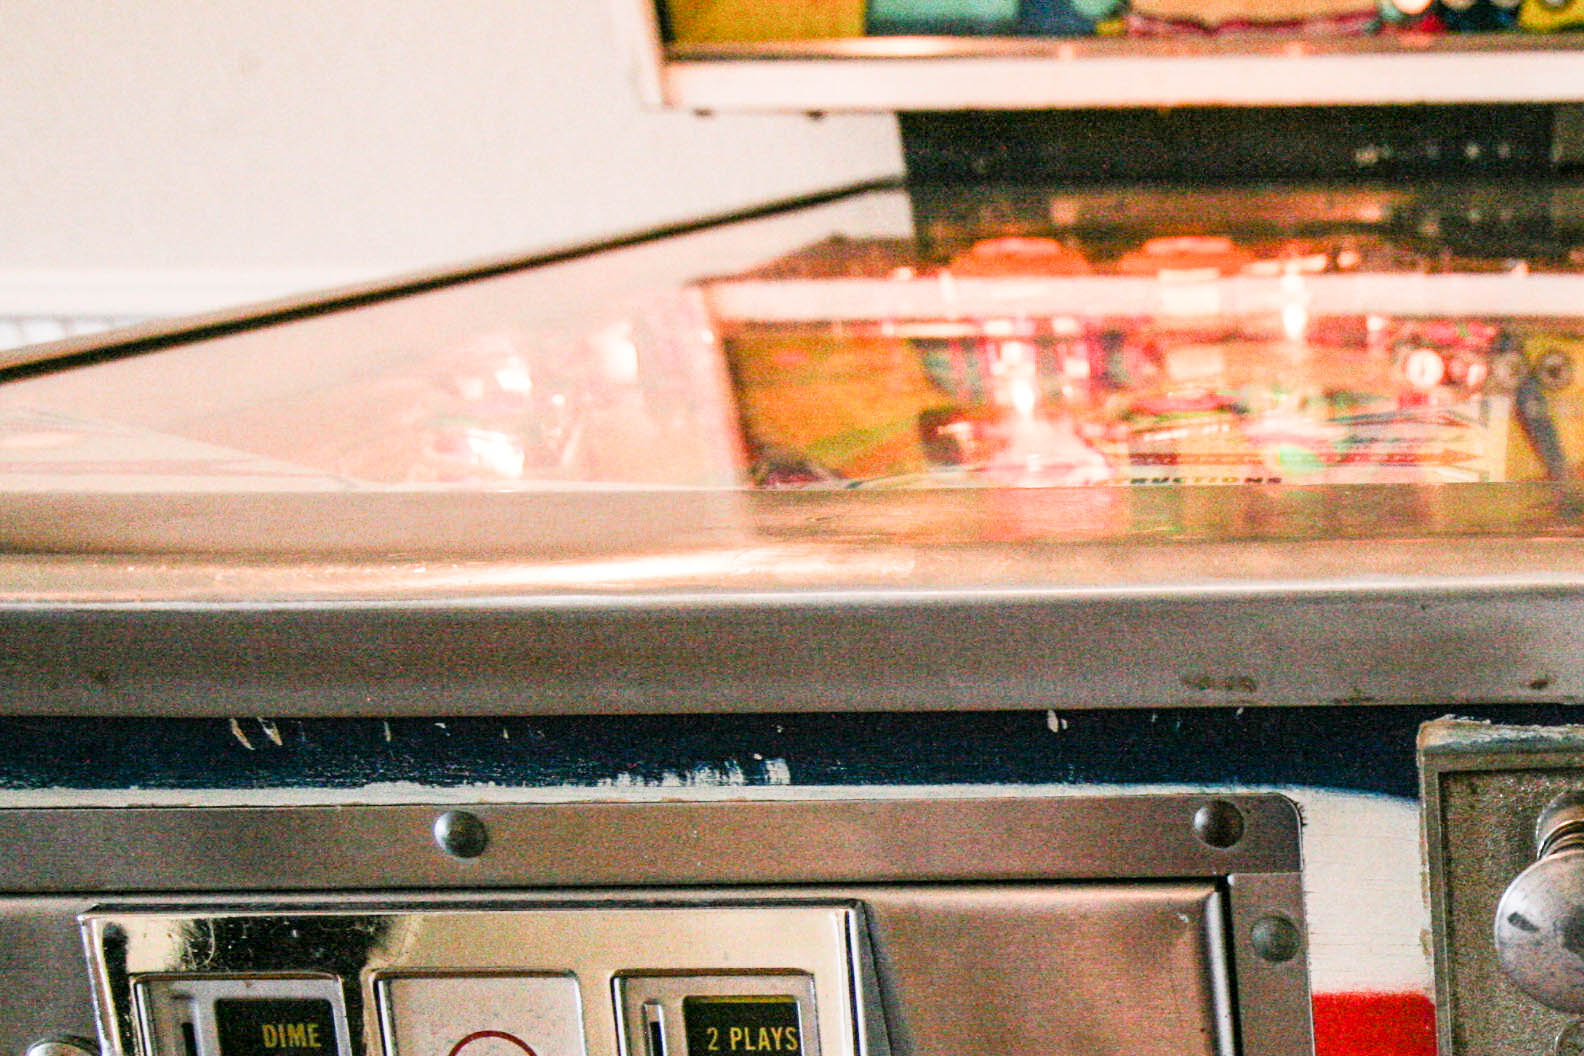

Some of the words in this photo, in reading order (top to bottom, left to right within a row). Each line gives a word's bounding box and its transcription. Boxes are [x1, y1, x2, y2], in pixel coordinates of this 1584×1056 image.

[261, 1023, 322, 1048] DIME
[706, 1026, 720, 1051] 2
[729, 1026, 800, 1052] PLAYS
